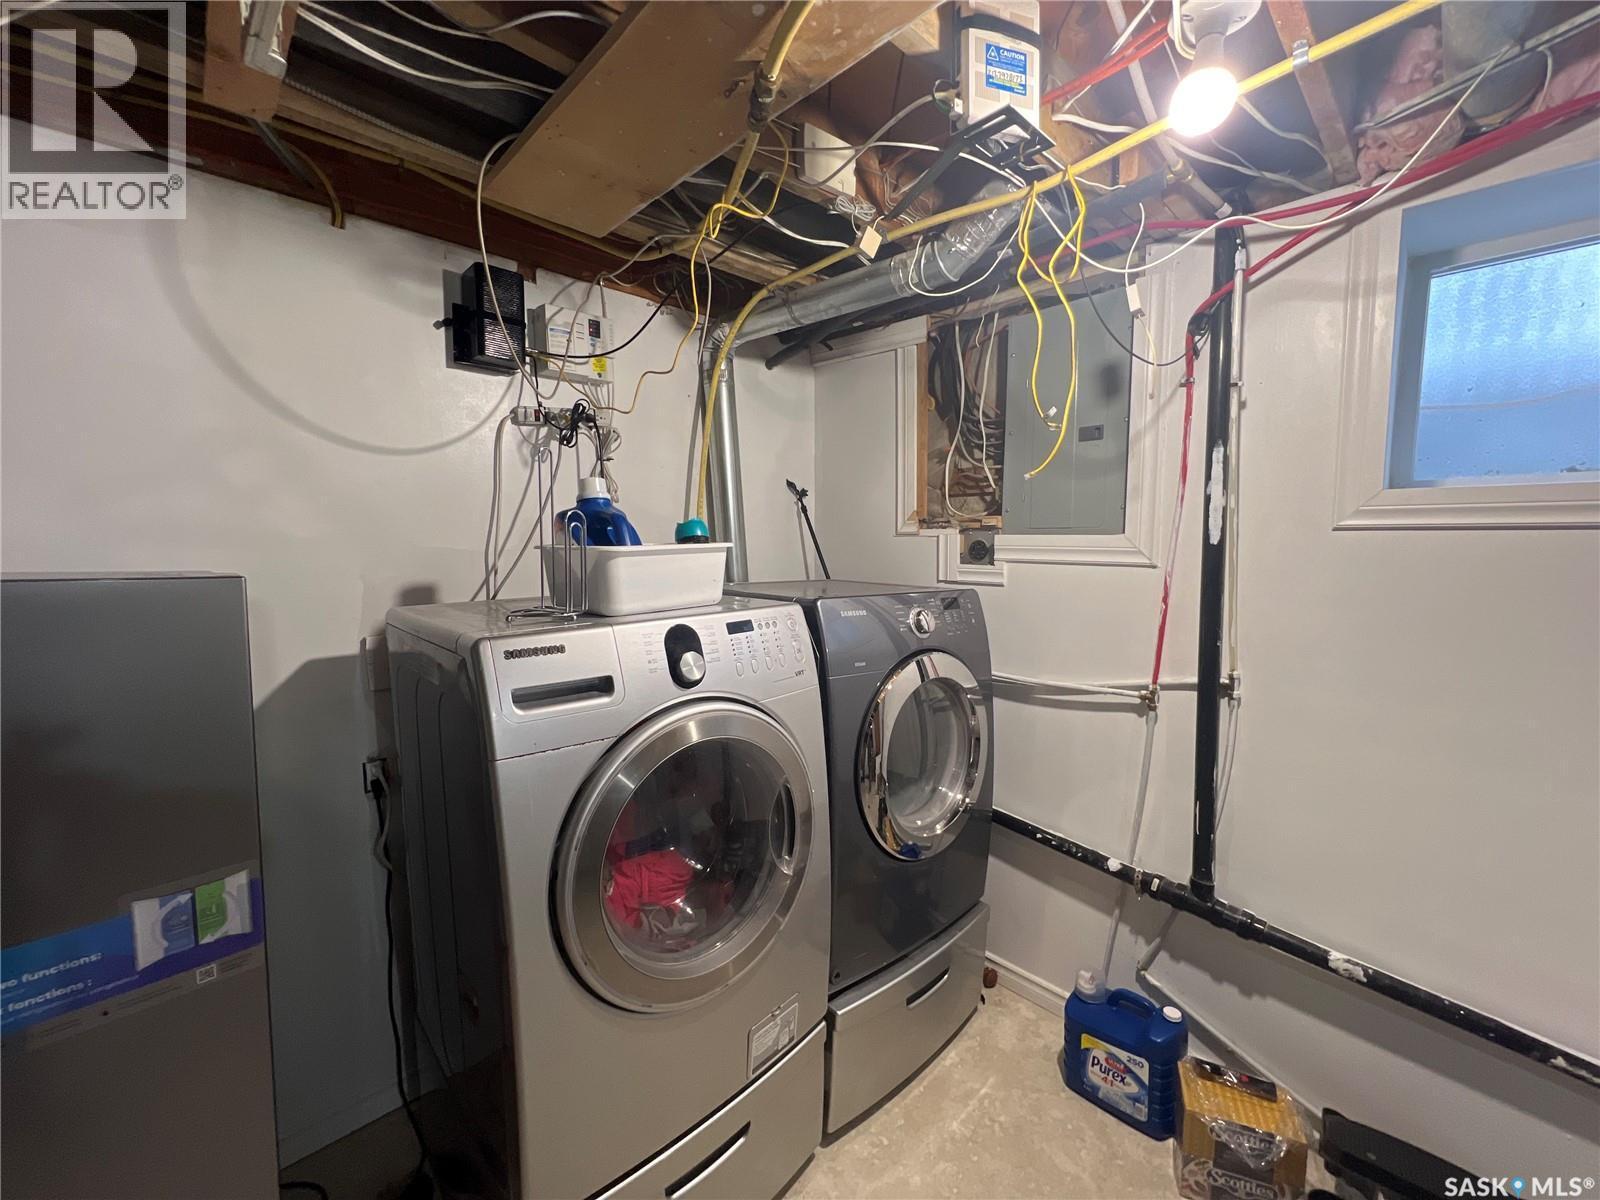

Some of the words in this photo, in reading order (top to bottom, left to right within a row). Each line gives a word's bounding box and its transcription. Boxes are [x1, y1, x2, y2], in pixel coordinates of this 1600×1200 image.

[999, 49, 1025, 61] CAUTION
[503, 644, 566, 660] SAMSUNG
[21, 952, 103, 983] functions:
[1091, 1055, 1128, 1086] Purex
[1126, 1055, 1144, 1069] 250
[1208, 1168, 1275, 1199] Scotties
